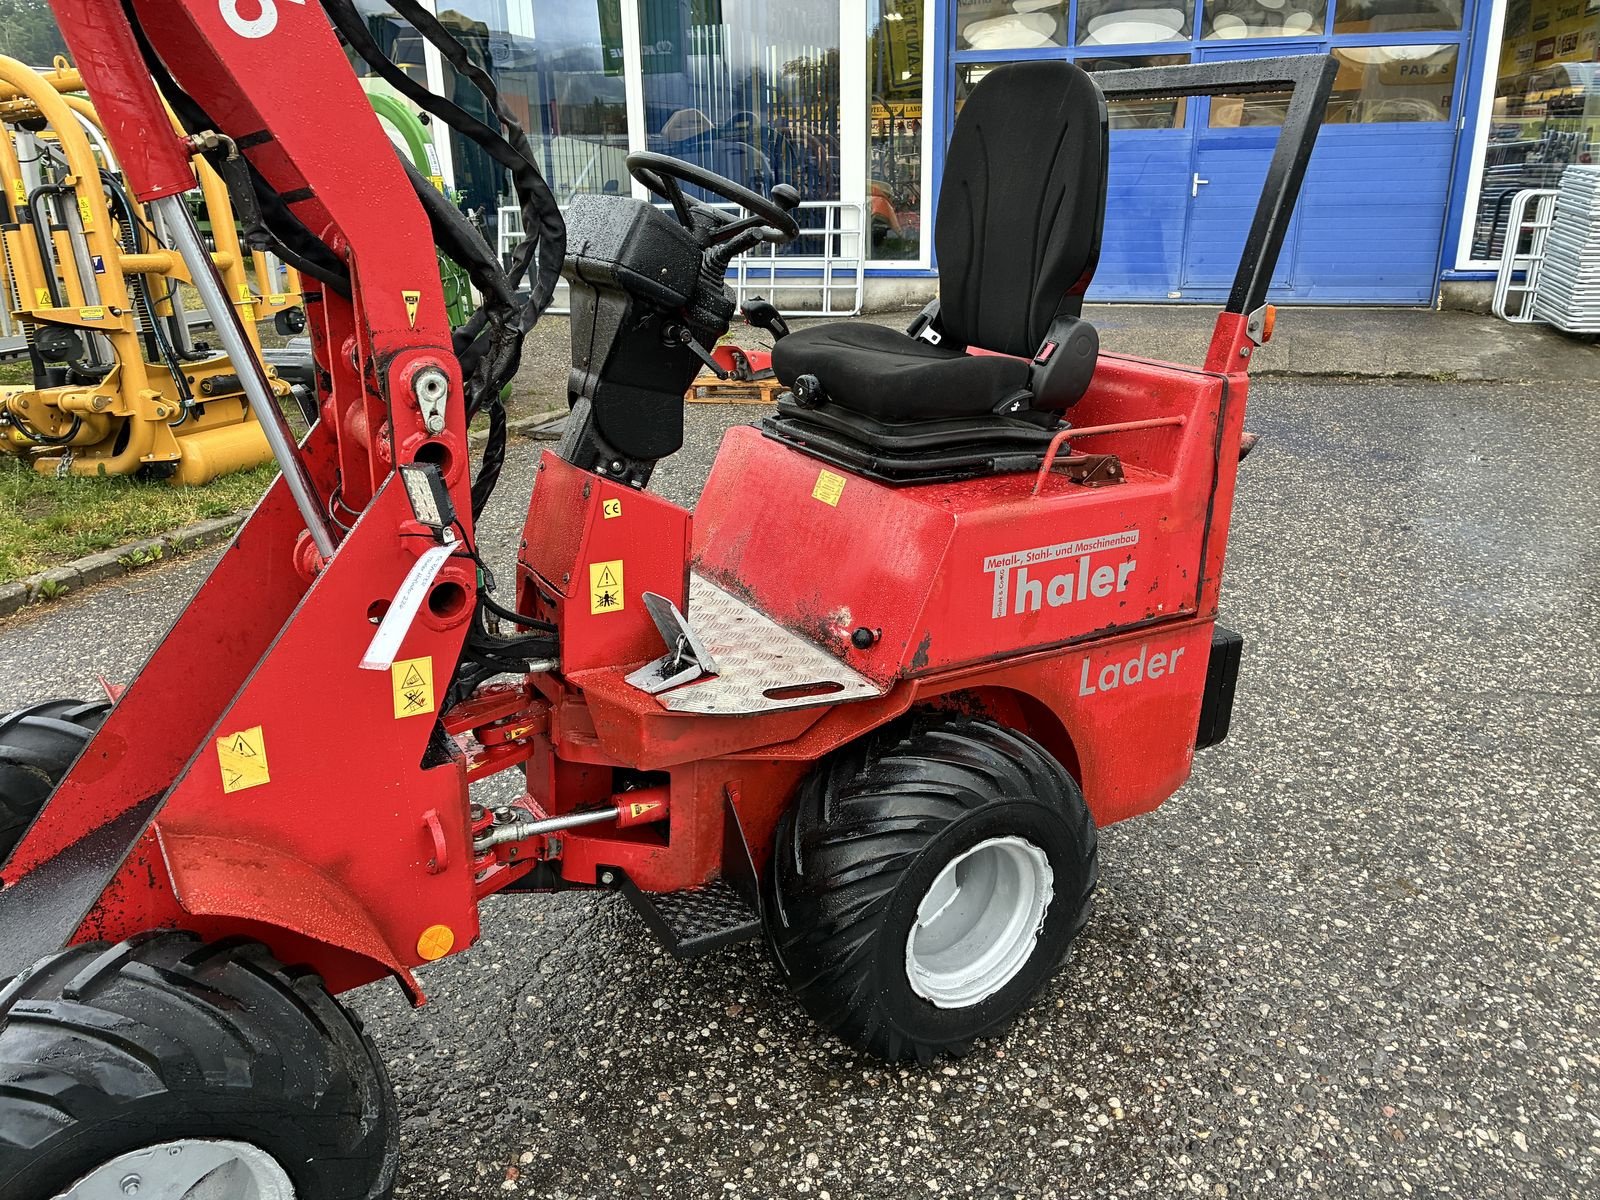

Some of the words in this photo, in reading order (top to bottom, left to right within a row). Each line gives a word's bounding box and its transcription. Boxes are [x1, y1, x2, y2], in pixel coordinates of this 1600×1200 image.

[1400, 63, 1449, 76] PARTS
[987, 556, 1024, 570] Metall-,
[1026, 550, 1053, 562] Stahl-
[1055, 545, 1073, 557] und
[1075, 534, 1137, 554] Maschinenbau
[984, 555, 1137, 619] Thaler
[1079, 644, 1185, 697] Lader
